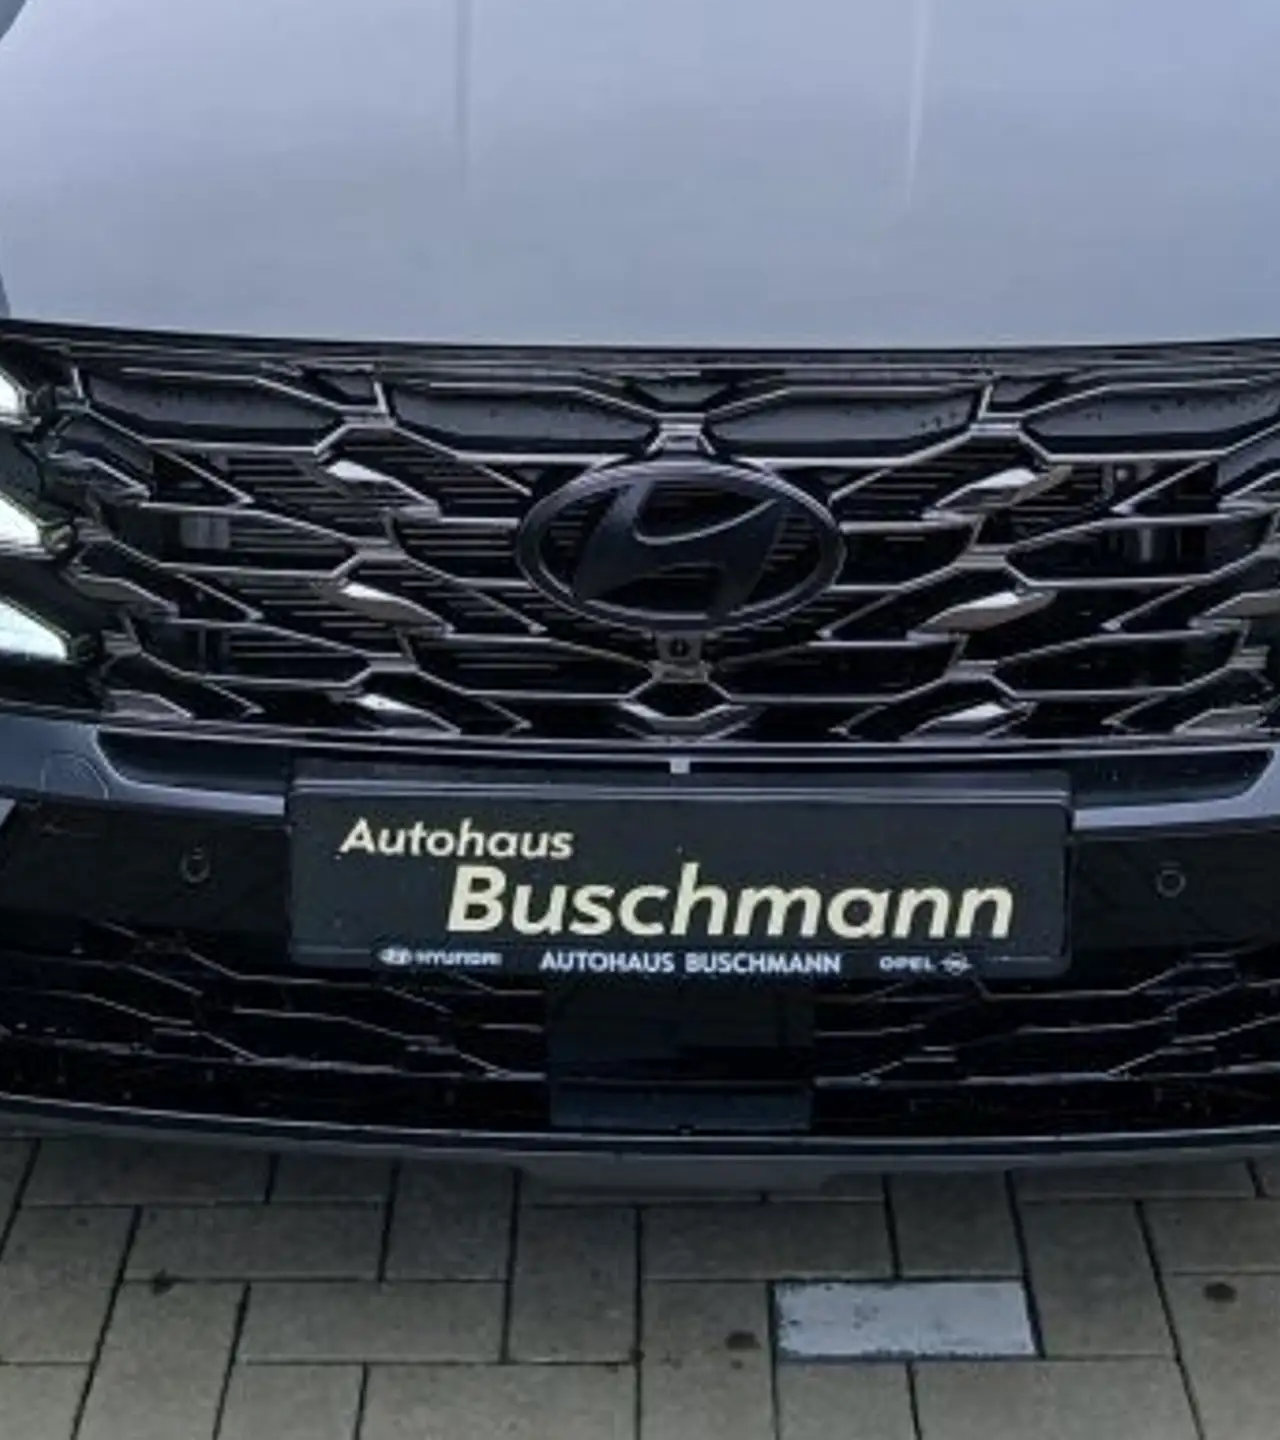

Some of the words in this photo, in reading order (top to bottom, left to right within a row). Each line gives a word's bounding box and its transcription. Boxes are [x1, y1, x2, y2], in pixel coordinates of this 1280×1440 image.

[338, 817, 574, 860] Autohaus
[446, 862, 1014, 939] Buschmann
[539, 950, 675, 973] AUTOHAUS
[684, 952, 842, 974] BUSCHMANN
[878, 954, 935, 972] OPEL
